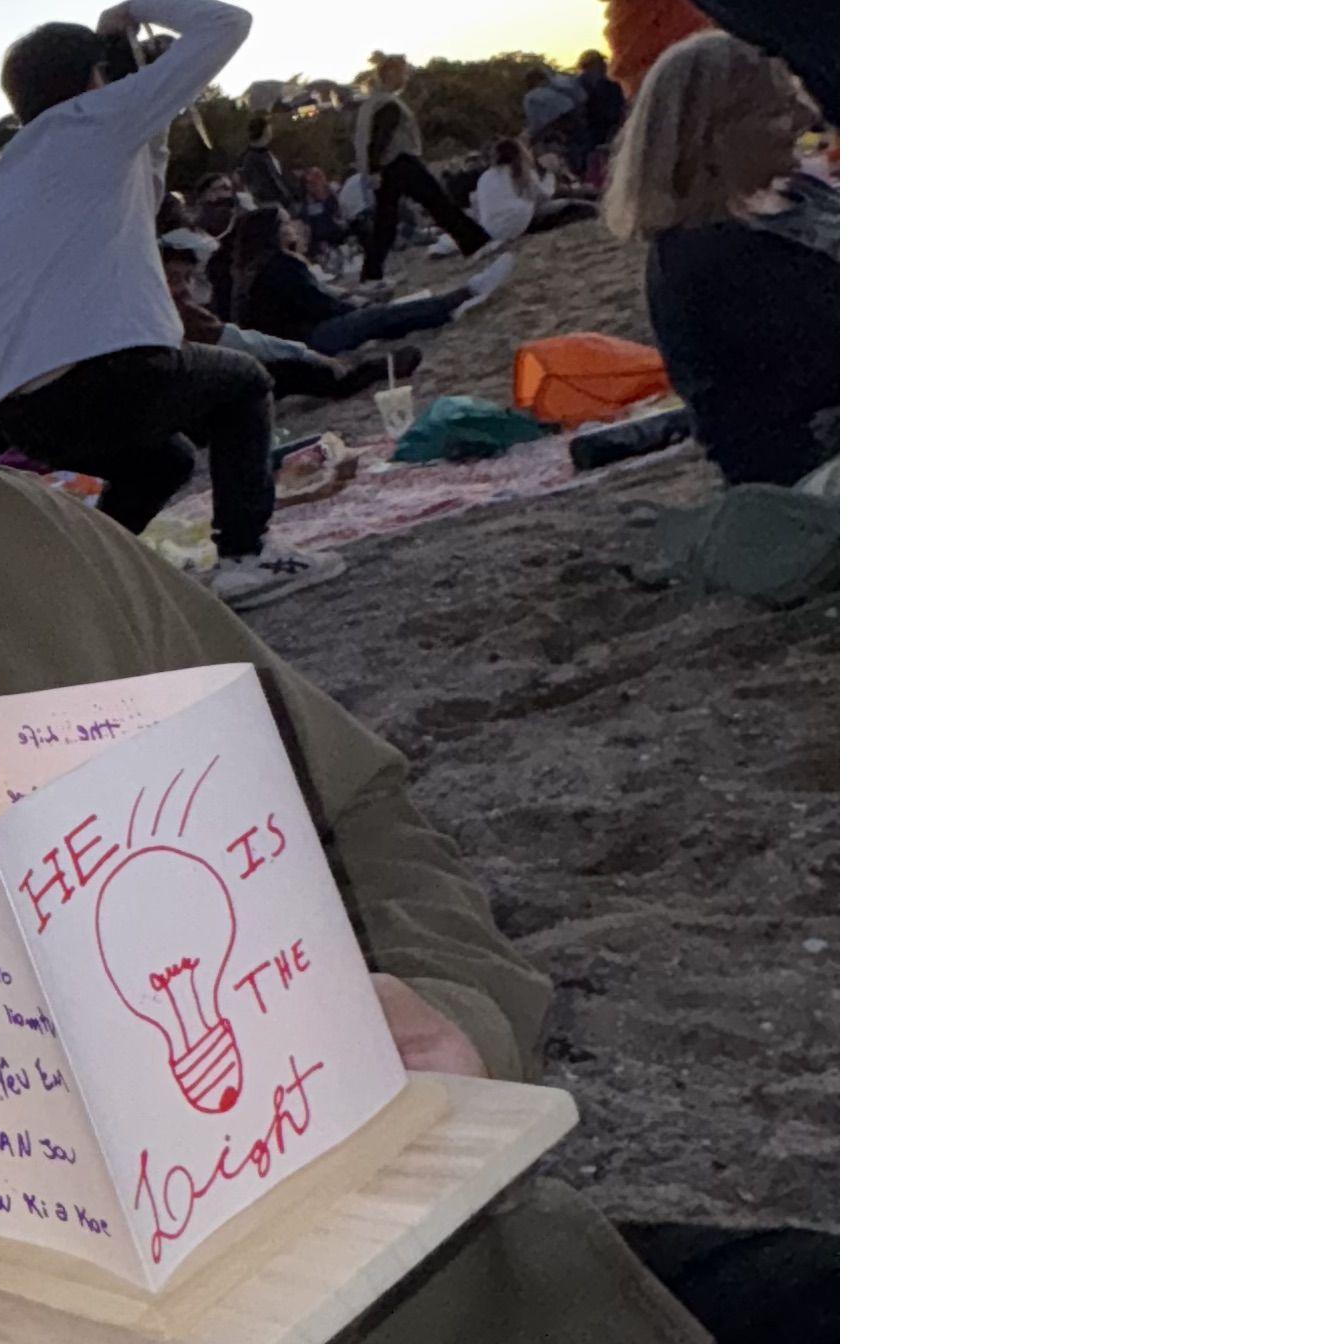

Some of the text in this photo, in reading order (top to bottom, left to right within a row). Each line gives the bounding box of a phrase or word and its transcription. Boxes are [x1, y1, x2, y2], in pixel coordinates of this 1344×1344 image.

[19, 812, 286, 935] HE IS
[233, 938, 311, 1014] THE
